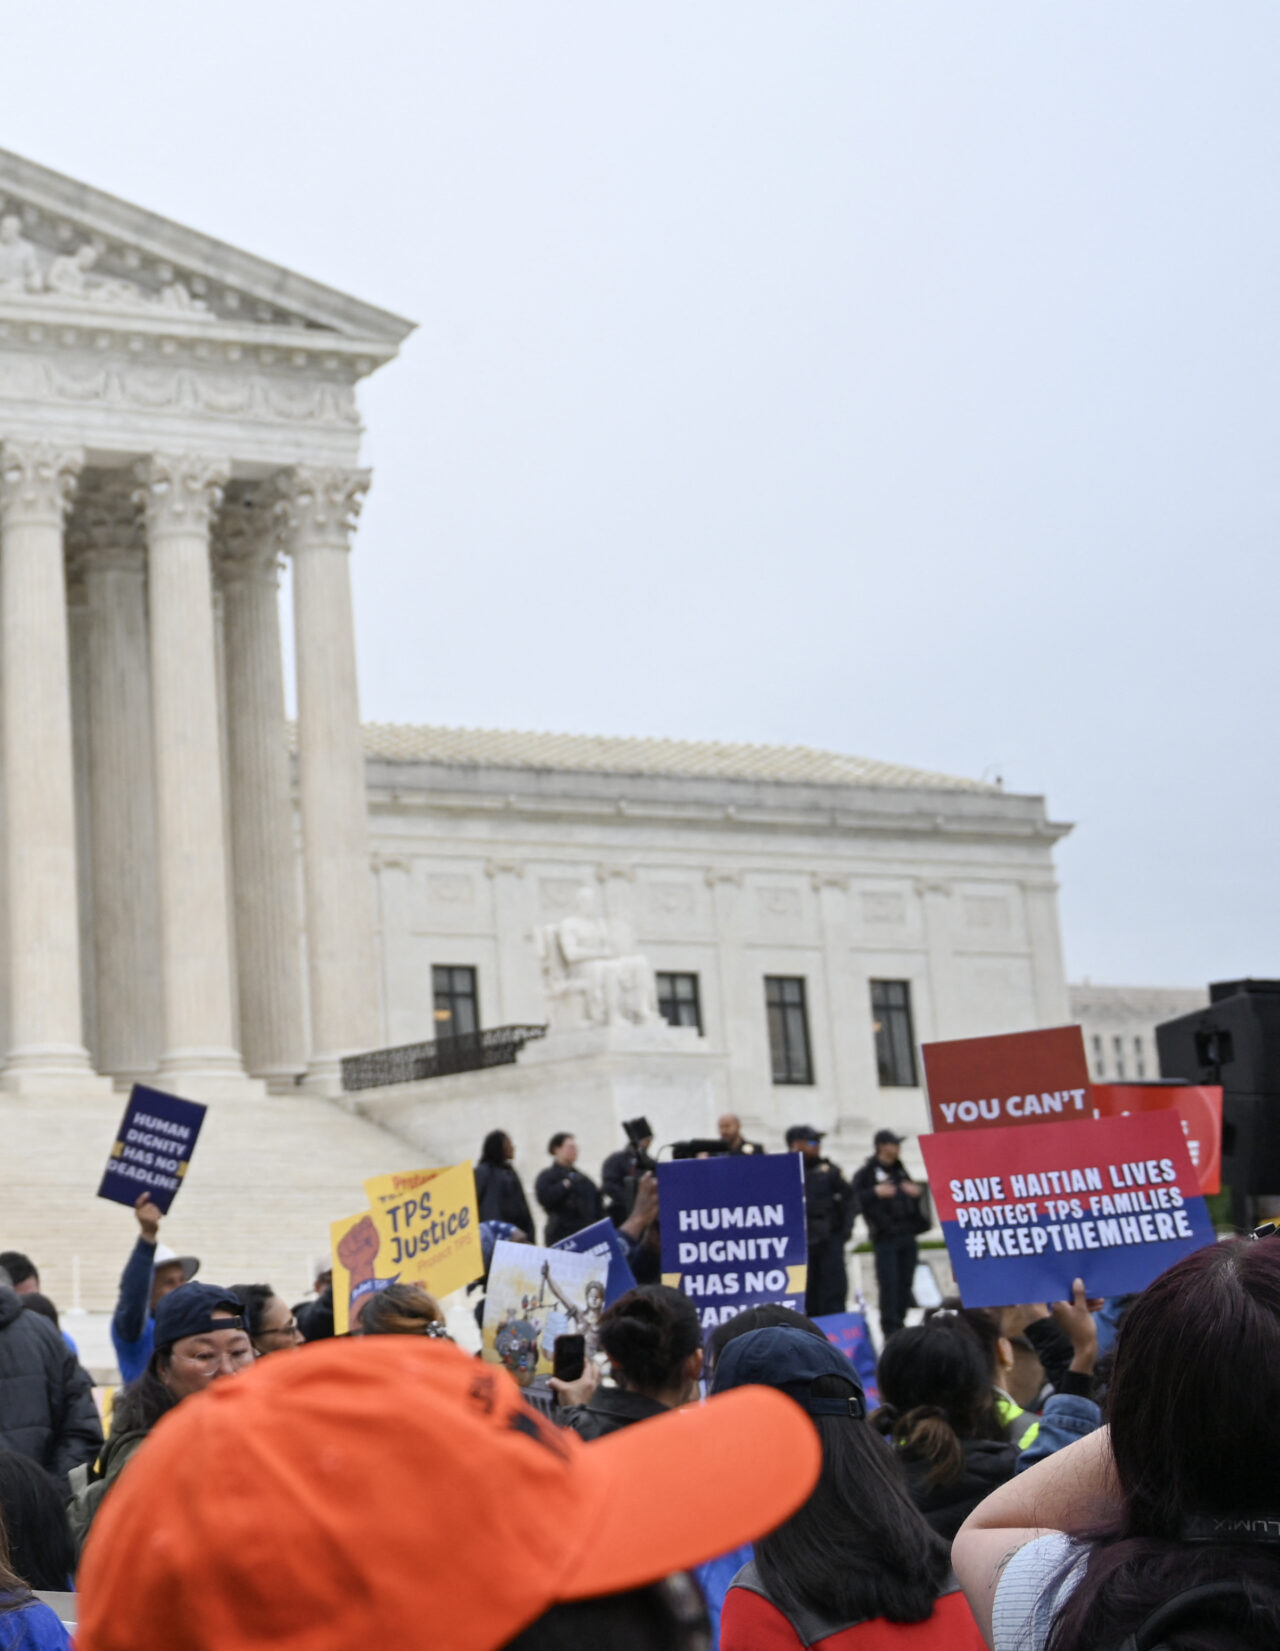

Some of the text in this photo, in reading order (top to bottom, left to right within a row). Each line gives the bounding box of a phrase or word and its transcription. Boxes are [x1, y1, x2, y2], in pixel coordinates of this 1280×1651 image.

[939, 1098, 1000, 1123] YOU
[1006, 1088, 1087, 1117] CAN'T
[133, 1111, 190, 1139] HUMAN
[126, 1128, 187, 1156] DIGNITY
[107, 1159, 179, 1190] DEADLINE
[122, 1145, 179, 1173] HAS NO
[949, 1158, 1177, 1204] SAVE HAITIAN LIVES
[386, 1191, 433, 1233] TPS
[678, 1204, 784, 1231] HUMAN
[956, 1187, 1185, 1229] PROTECT TPS FAMILIES
[390, 1206, 470, 1264] Justice
[964, 1210, 1194, 1259] #KEEPTHEMHERE
[678, 1237, 789, 1264] DIGNITY
[684, 1269, 786, 1296] HAS NO
